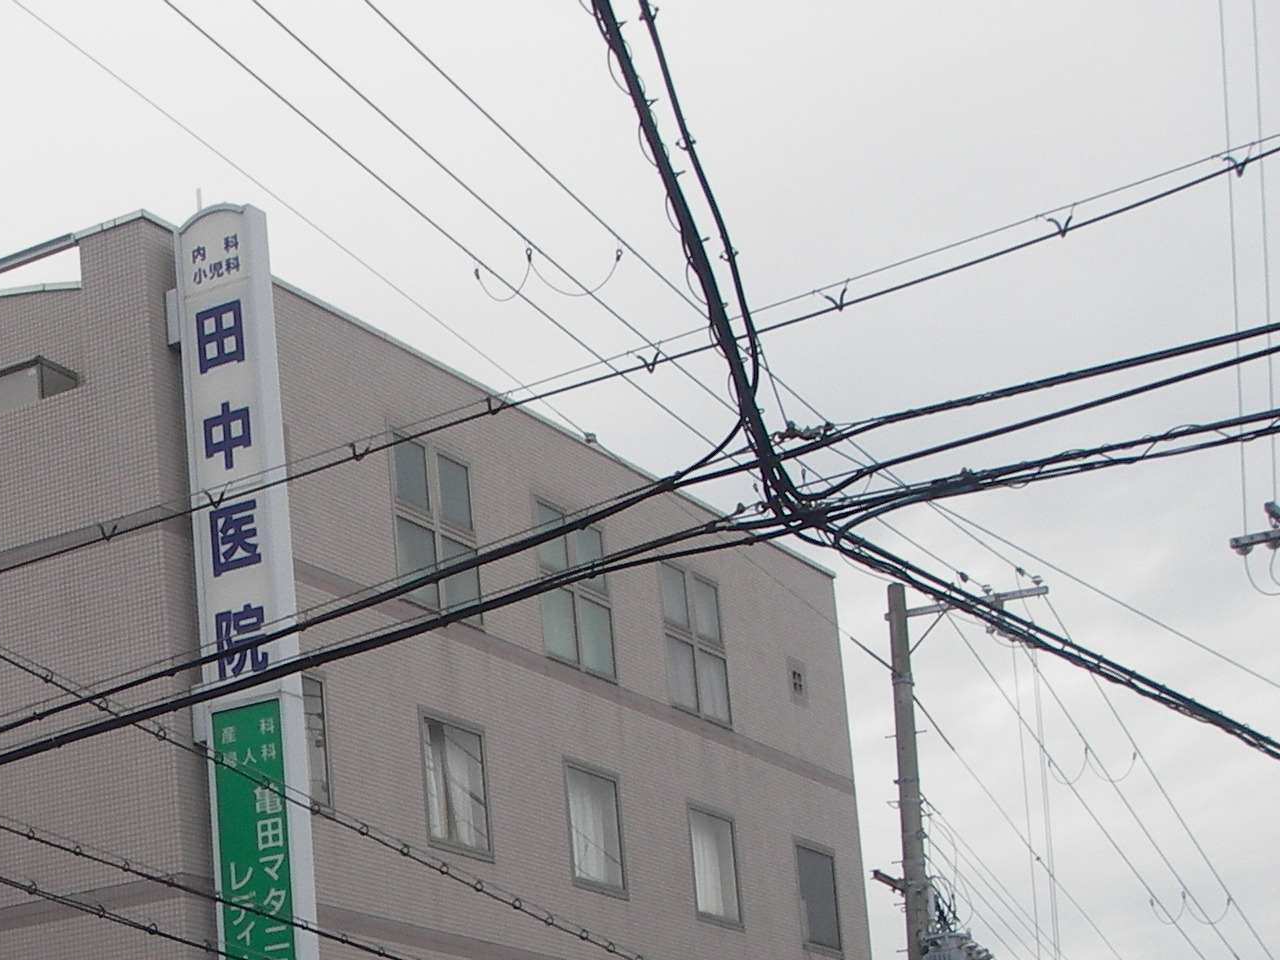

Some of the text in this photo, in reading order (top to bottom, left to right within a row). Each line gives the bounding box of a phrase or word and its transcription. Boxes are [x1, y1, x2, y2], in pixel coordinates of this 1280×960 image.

[193, 256, 240, 286] 小児科
[196, 299, 269, 681] 田中医院
